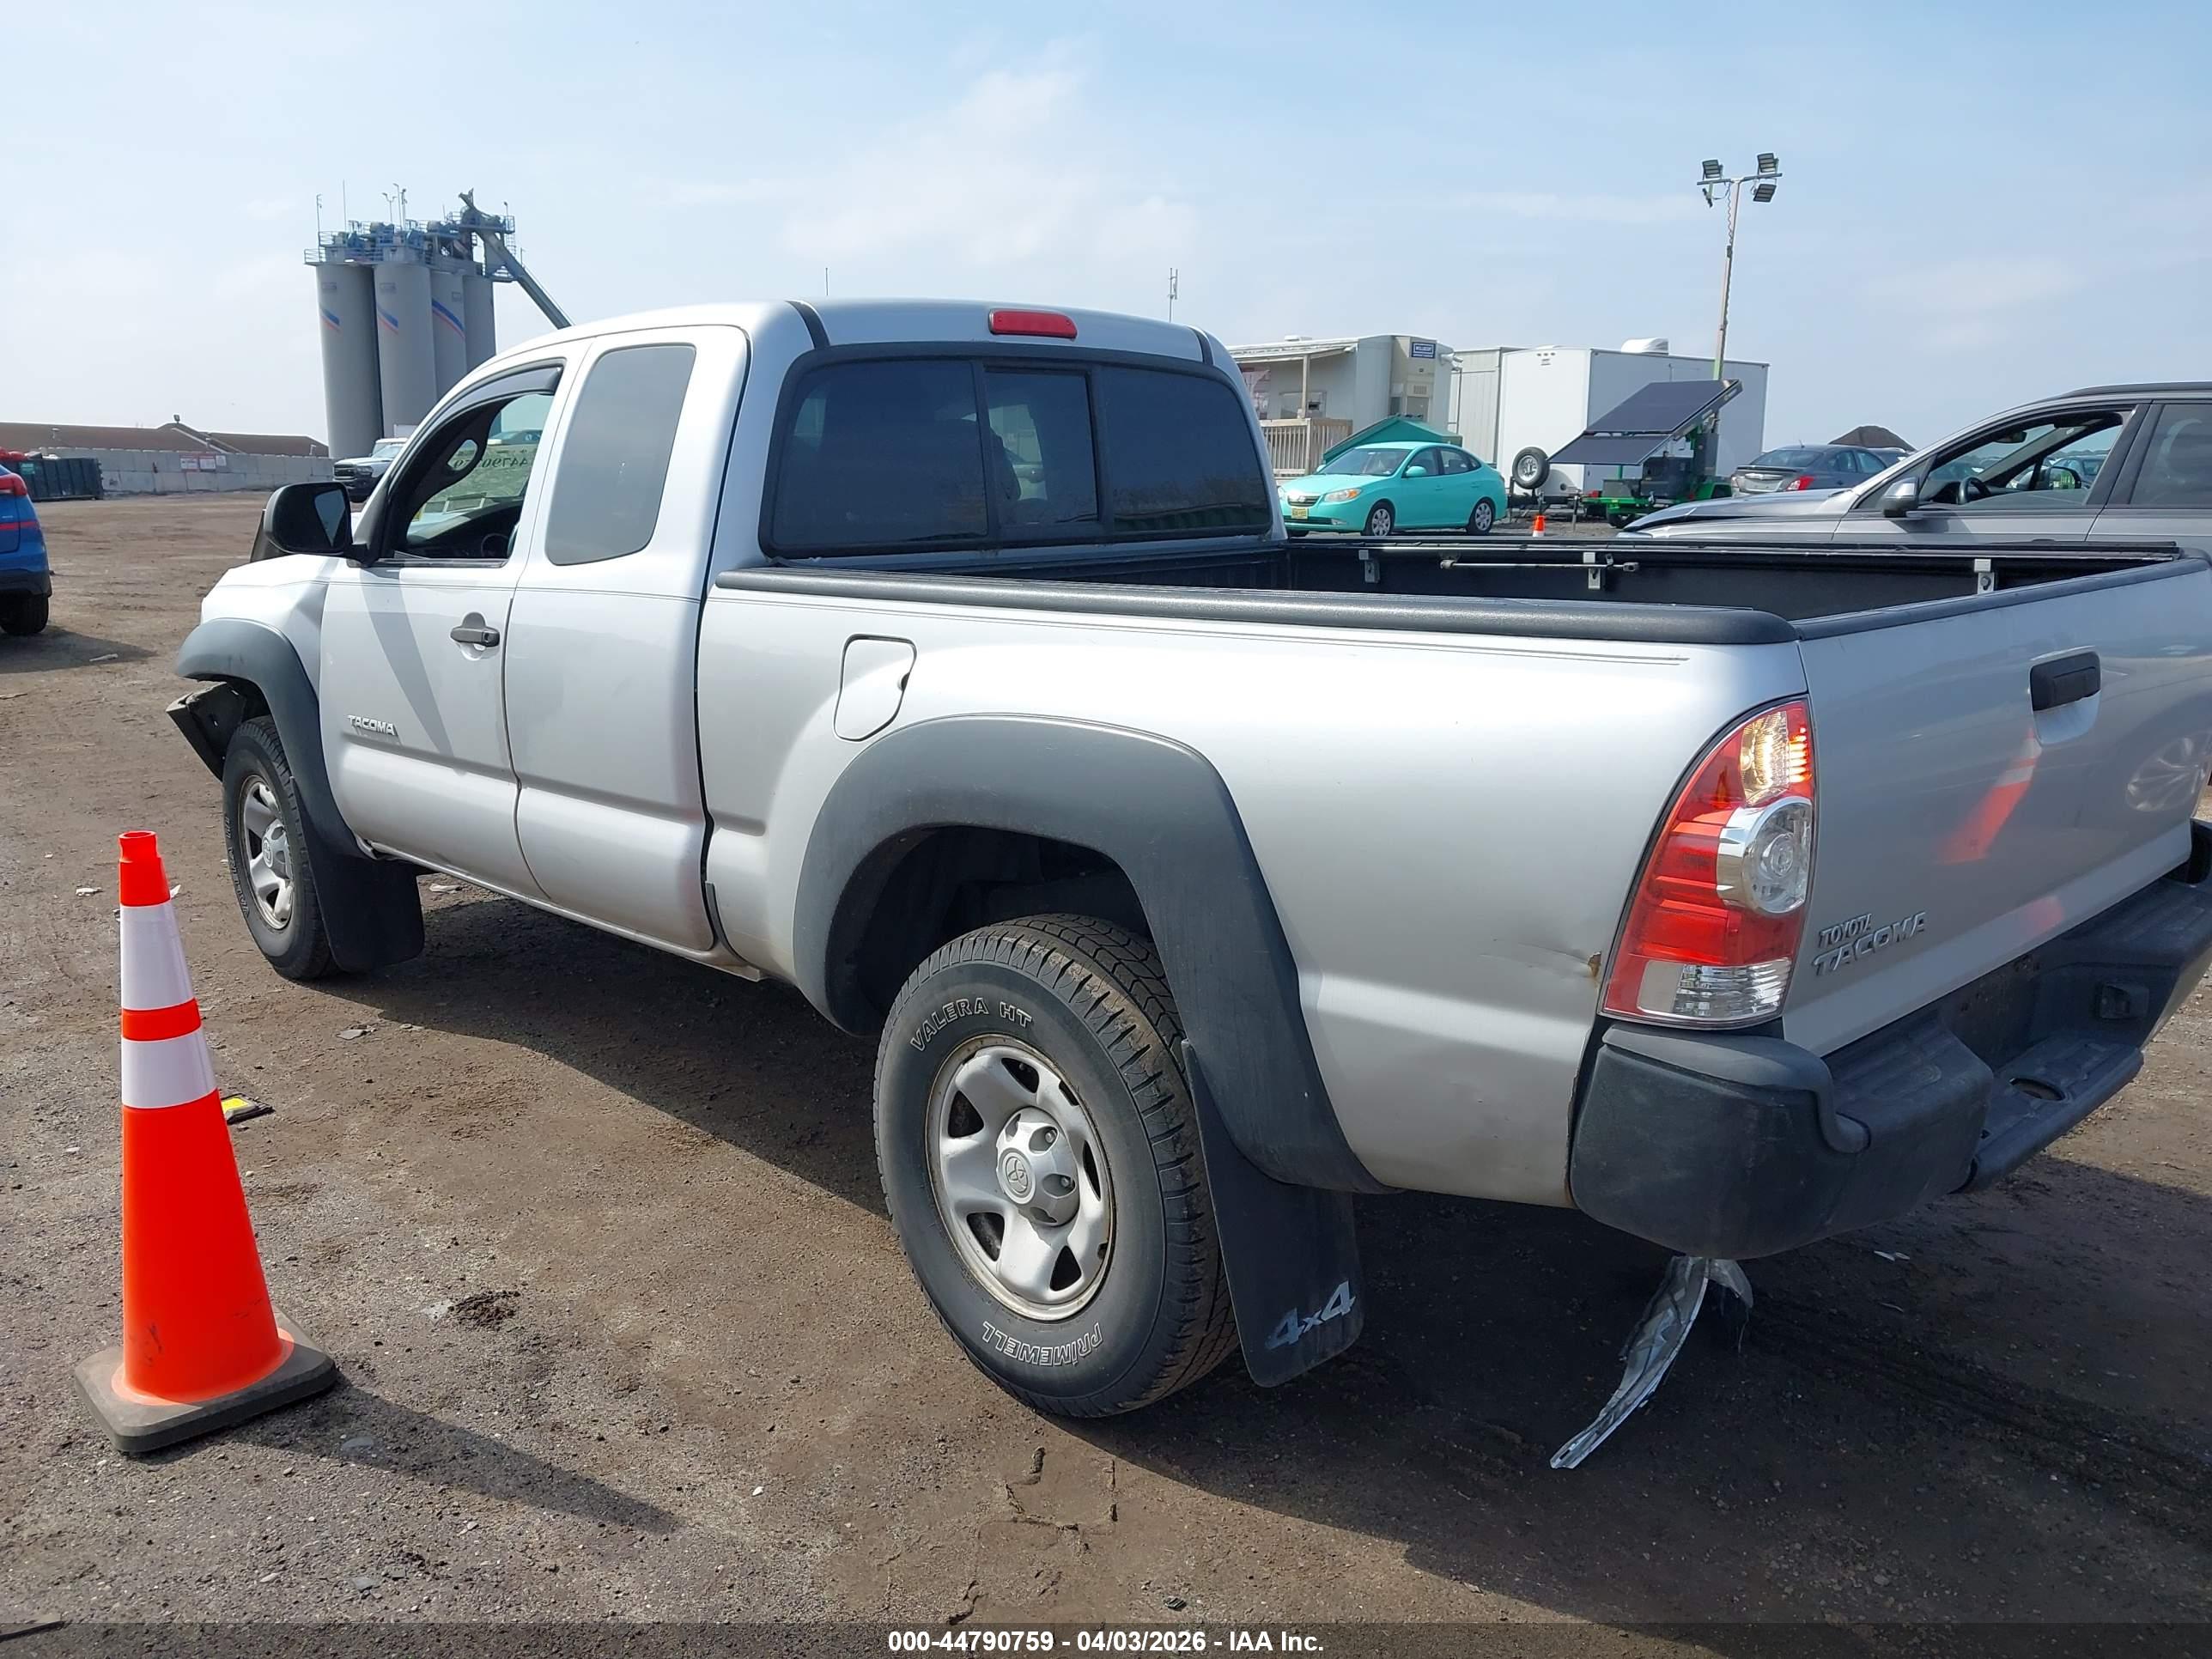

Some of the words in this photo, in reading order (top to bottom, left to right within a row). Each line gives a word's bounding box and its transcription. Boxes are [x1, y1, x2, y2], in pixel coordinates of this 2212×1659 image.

[347, 714, 397, 736] TACOMA
[1813, 911, 1926, 975] TACOMA
[1819, 913, 1872, 946] TOYOTA
[910, 997, 989, 1052] VALERA
[1000, 1001, 1032, 1028] HT
[1265, 1280, 1356, 1350] 4x4
